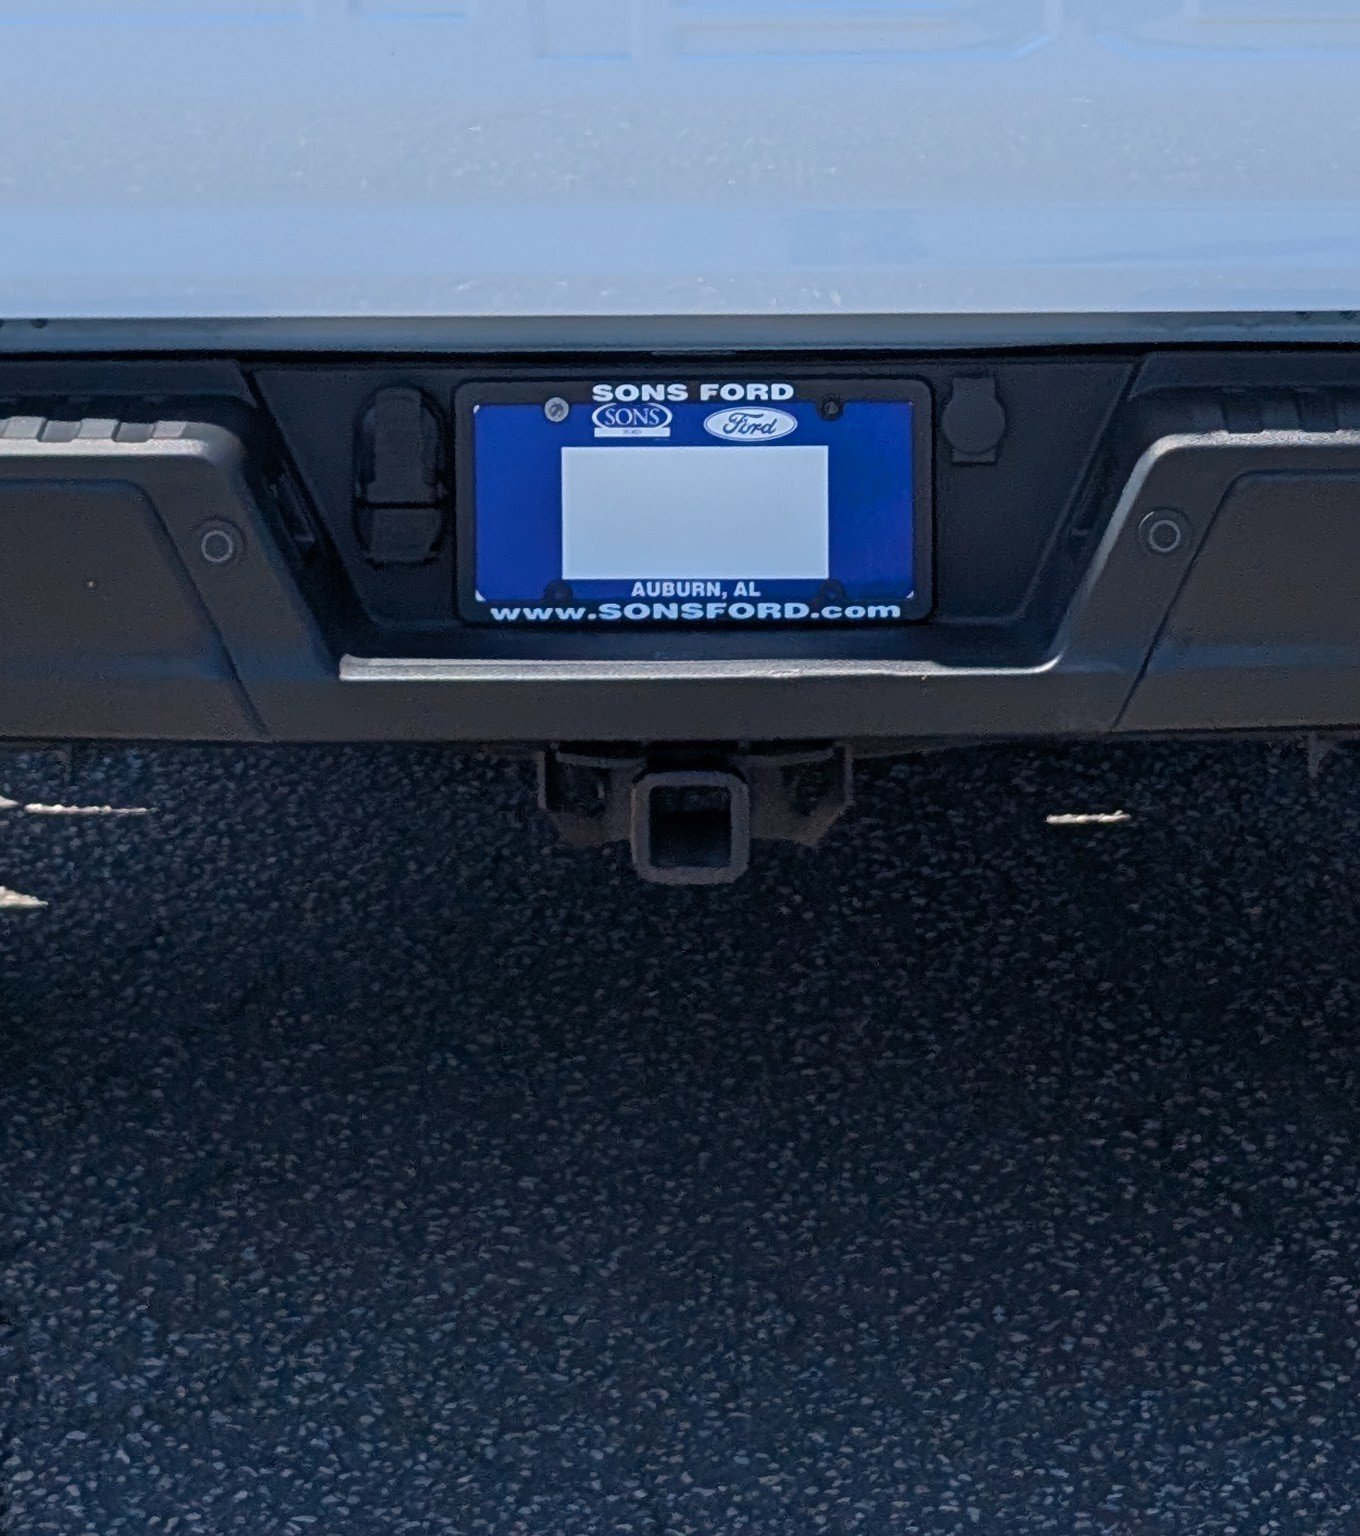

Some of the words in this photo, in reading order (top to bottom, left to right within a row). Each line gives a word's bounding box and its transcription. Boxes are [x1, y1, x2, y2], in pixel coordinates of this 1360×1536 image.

[591, 383, 689, 402] SONS
[699, 383, 794, 402] FORD
[604, 407, 661, 426] SONS
[722, 412, 778, 435] Ford
[631, 581, 728, 600] AUBURN,
[733, 581, 762, 598] AL
[489, 602, 902, 621] www.SONSFORD.com
